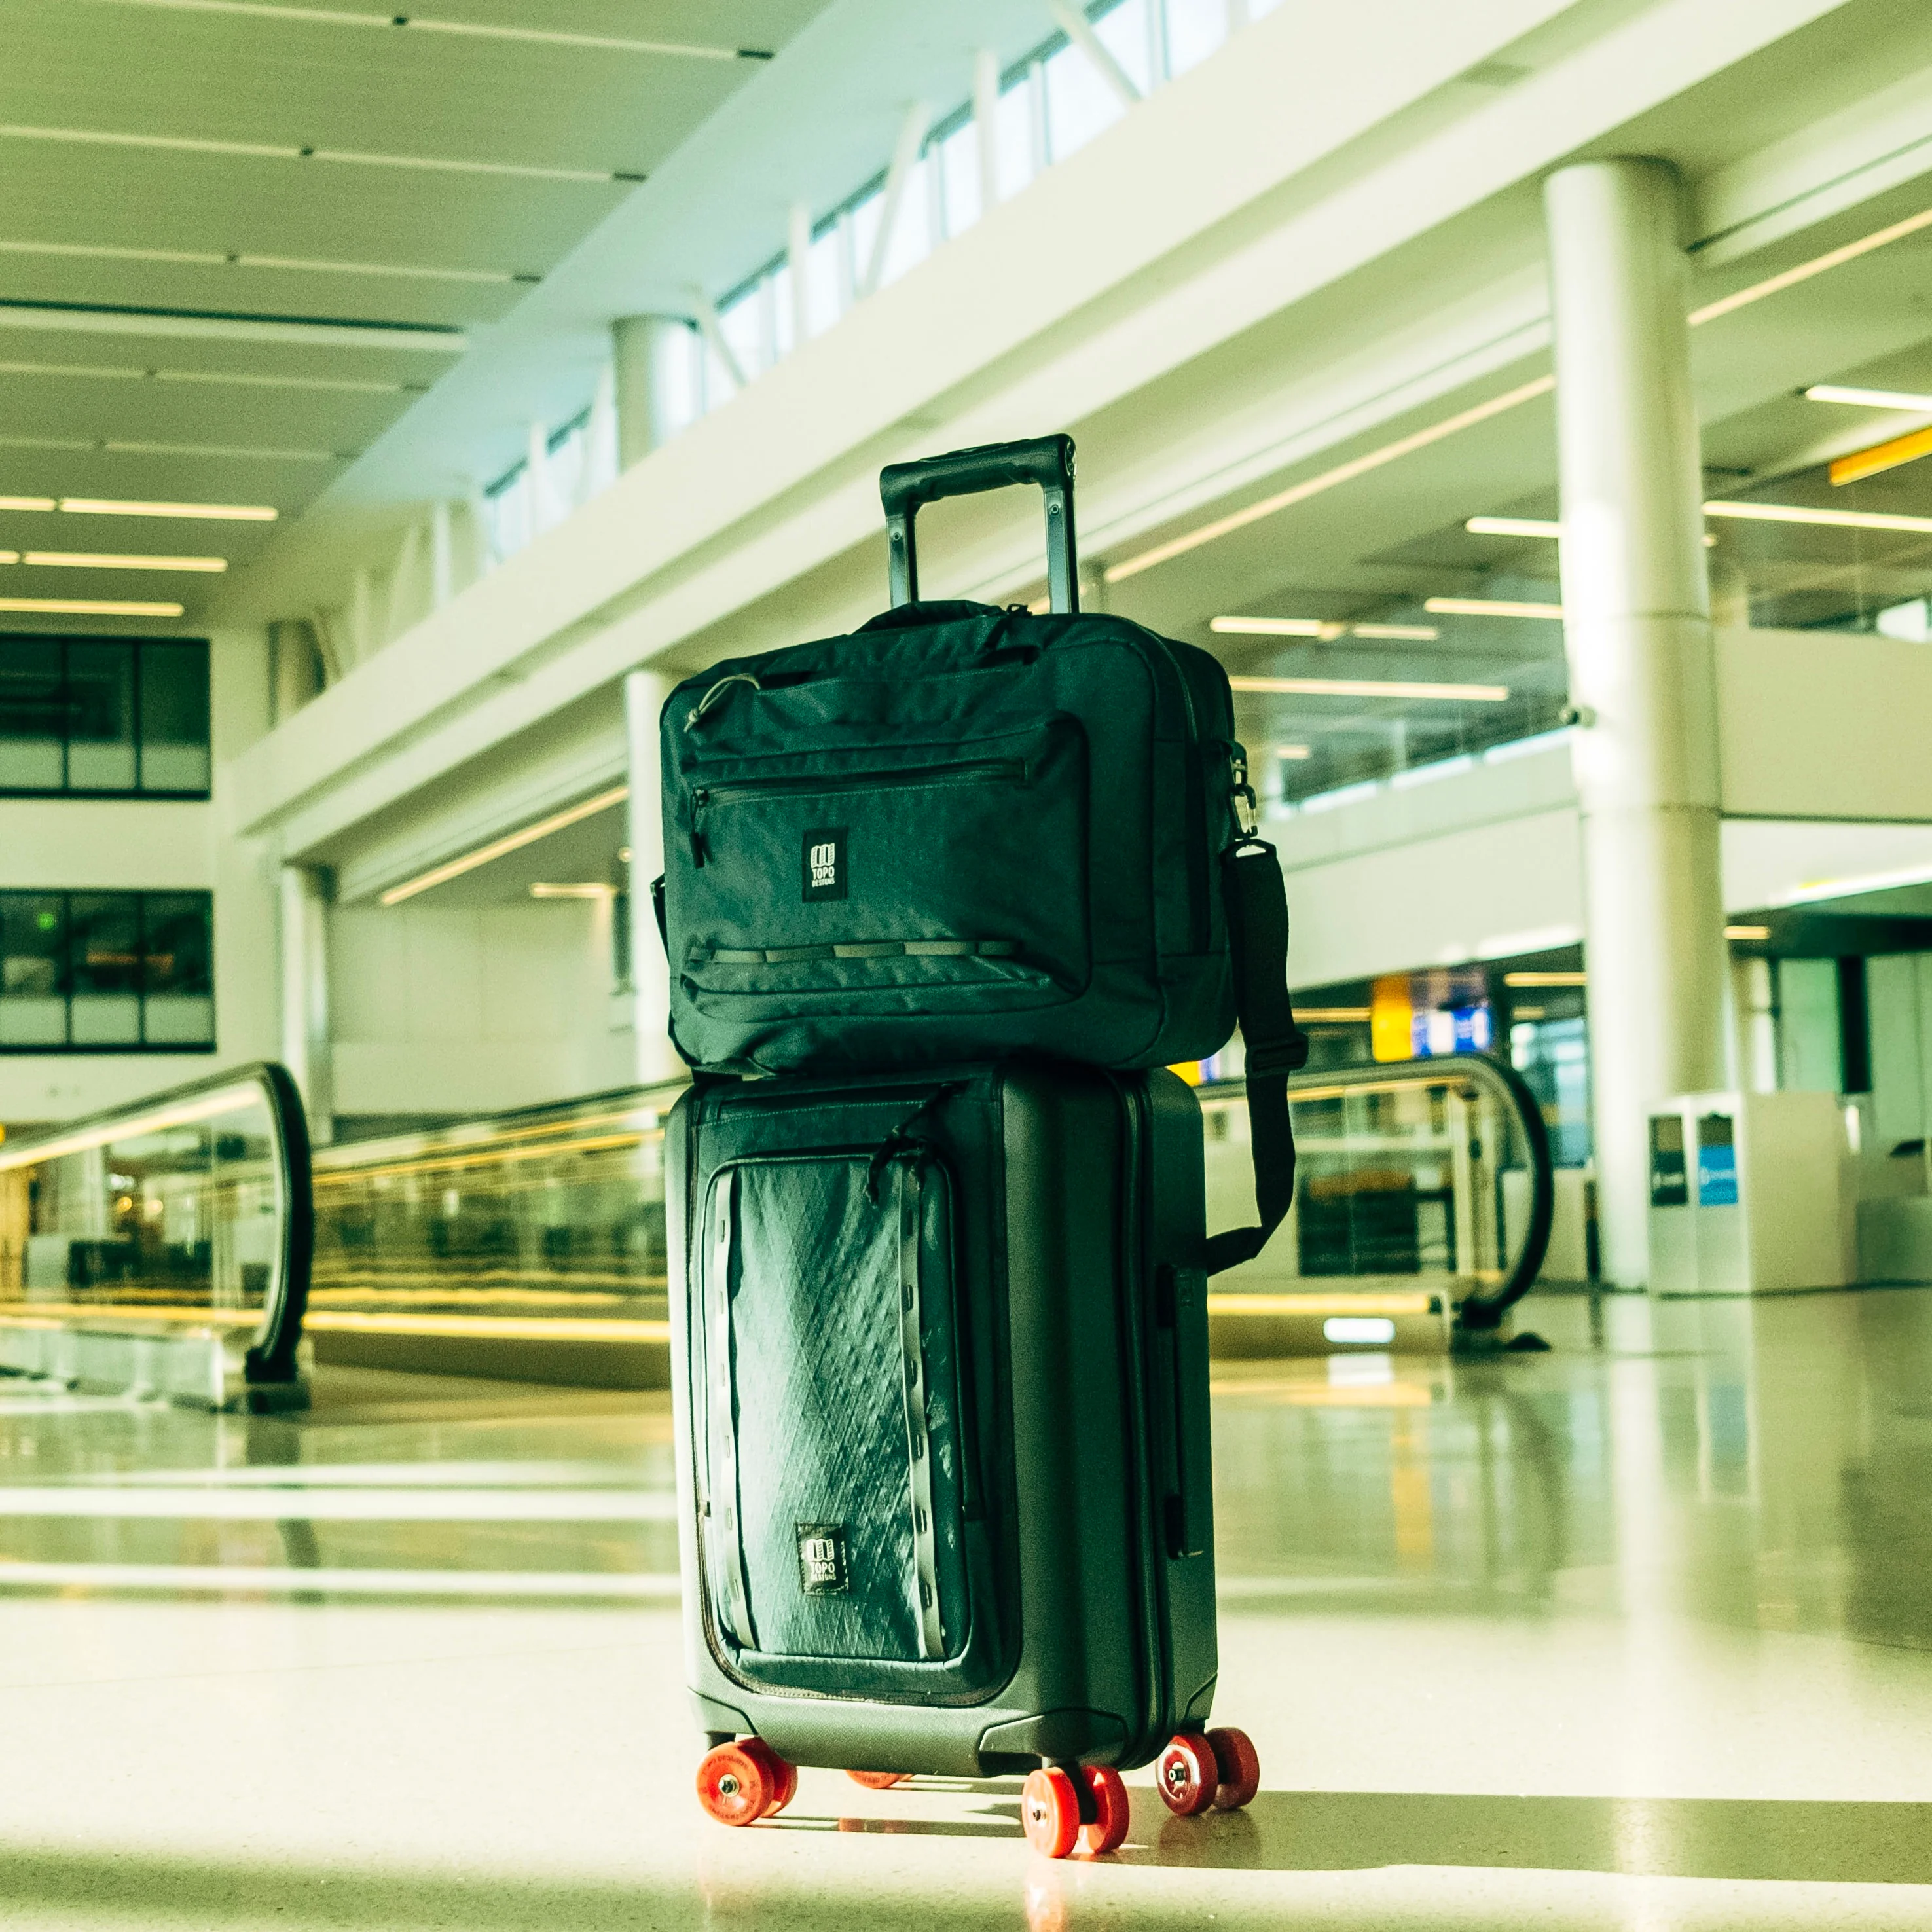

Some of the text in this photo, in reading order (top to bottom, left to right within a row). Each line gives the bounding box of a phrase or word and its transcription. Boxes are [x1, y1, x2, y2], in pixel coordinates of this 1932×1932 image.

[812, 866, 835, 879] TOPO
[812, 877, 835, 887] DESIGNS
[809, 1562, 835, 1573] TOPO
